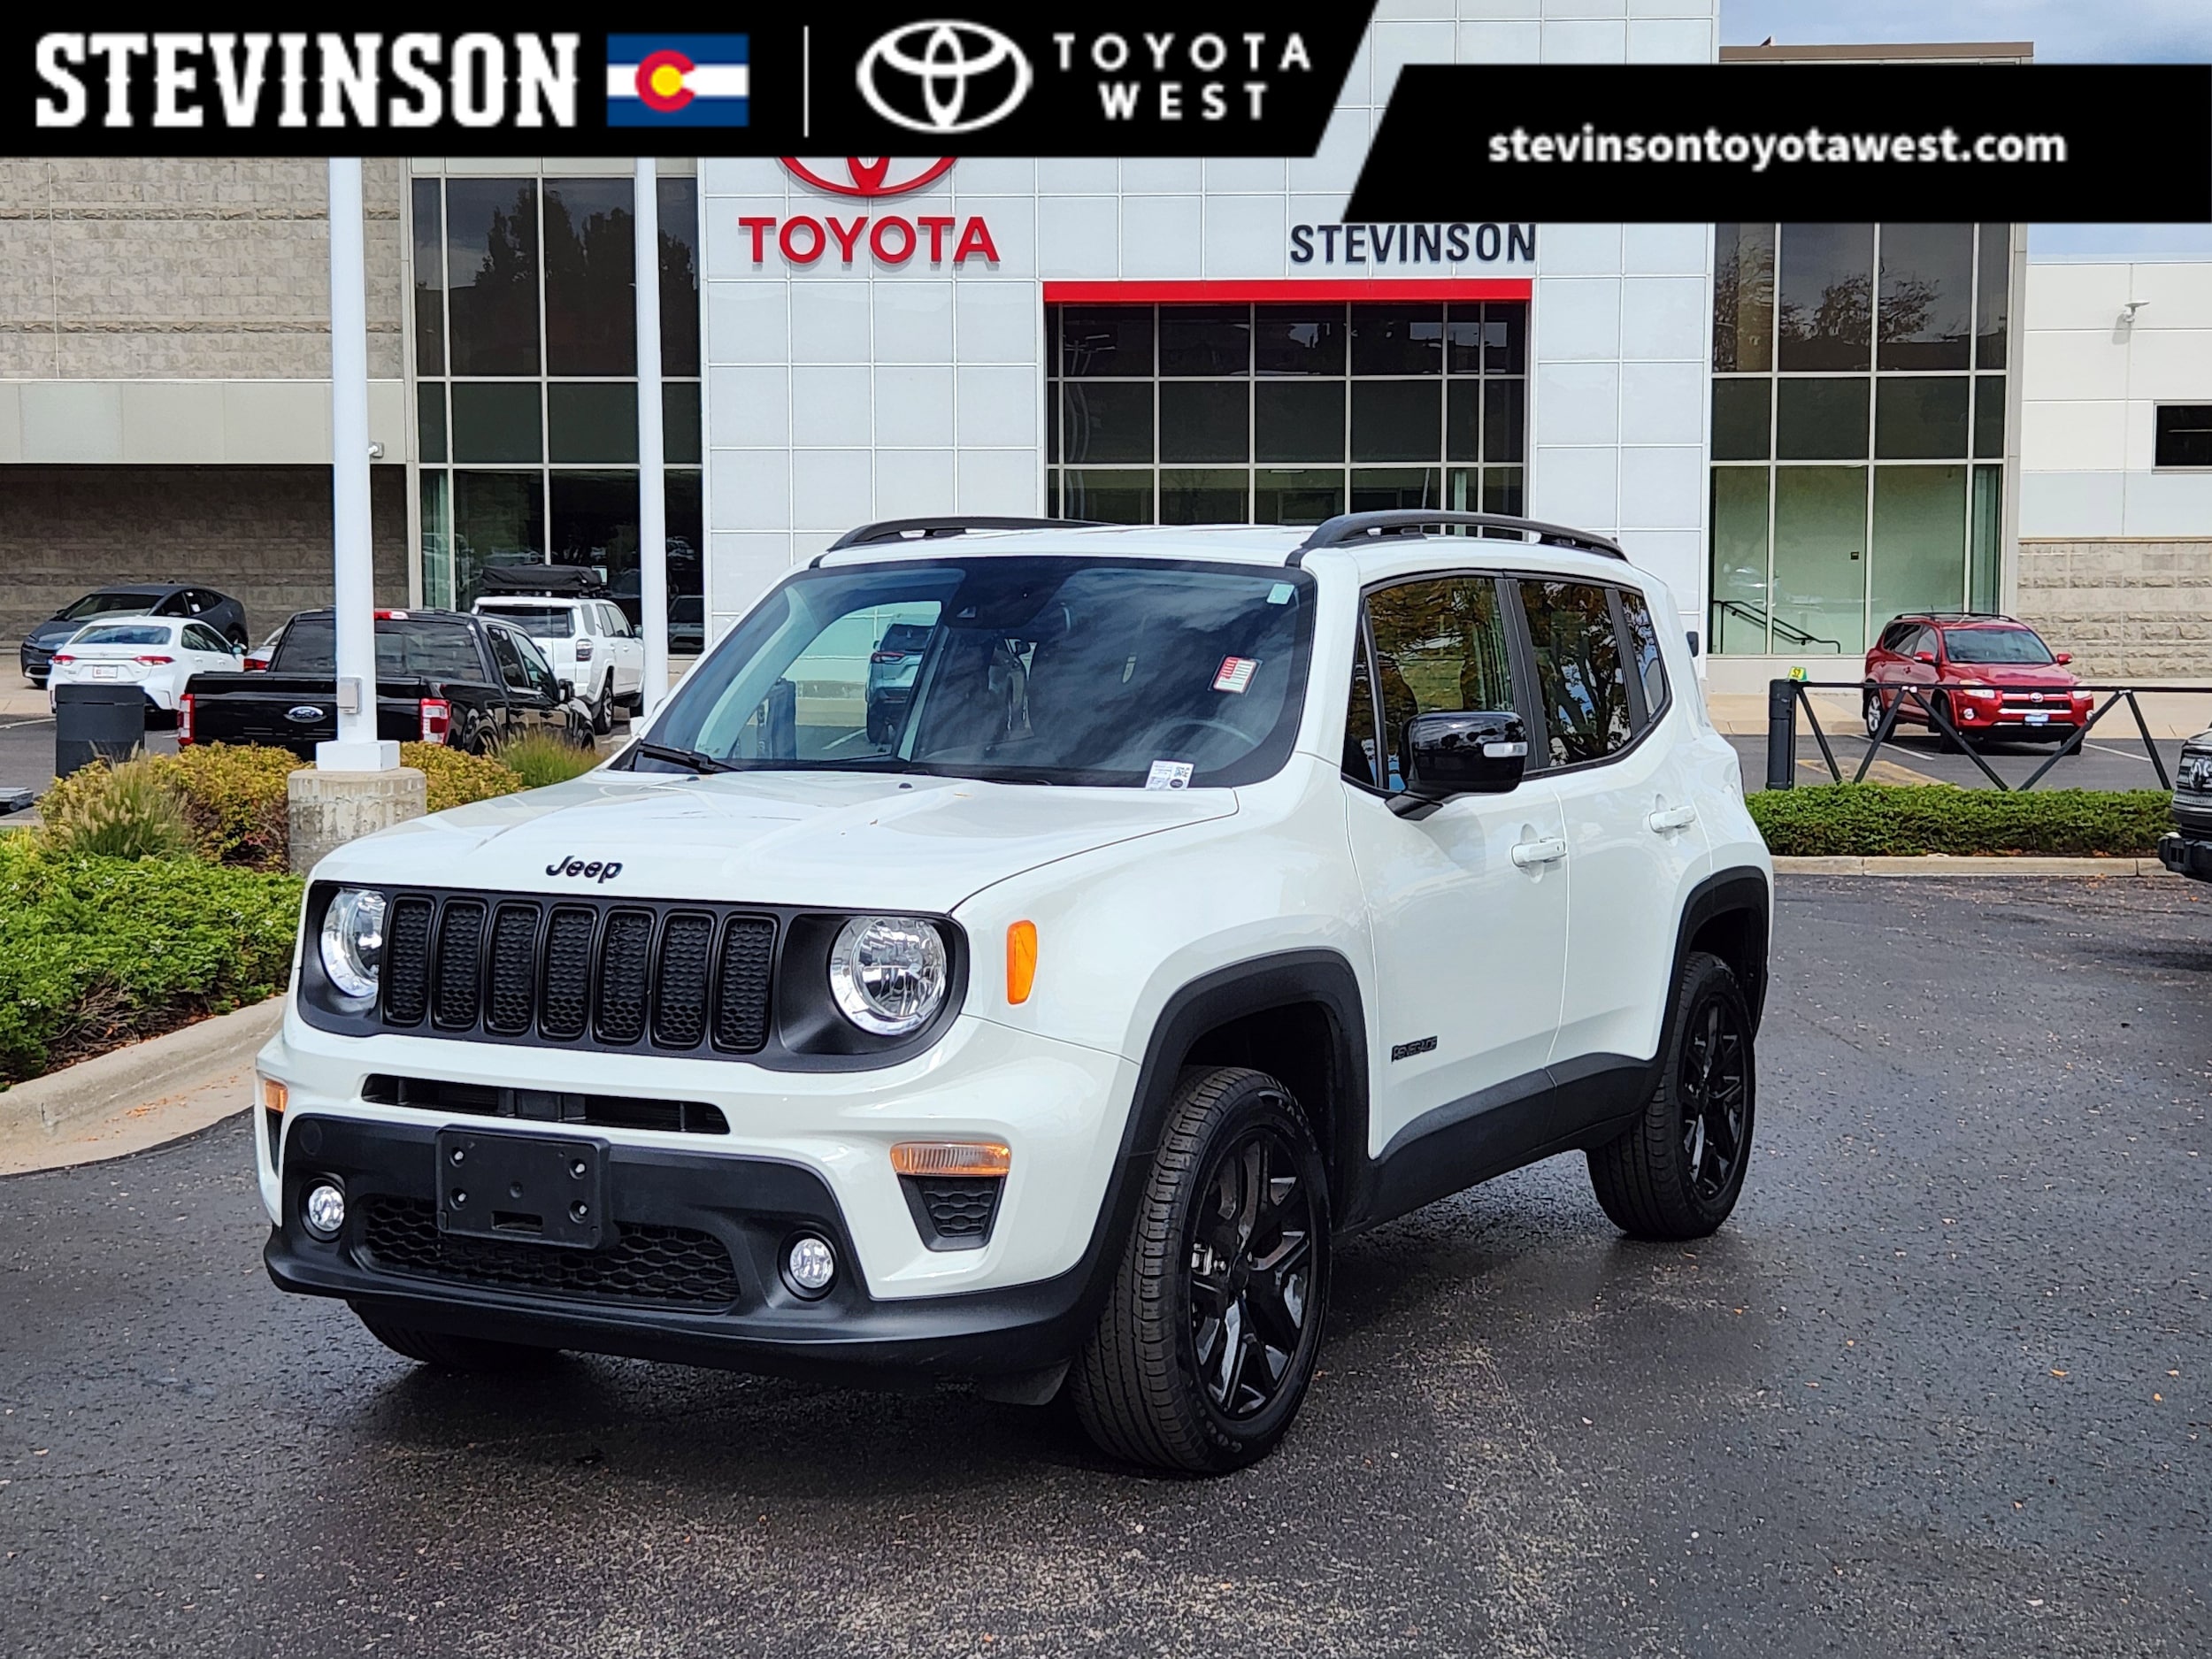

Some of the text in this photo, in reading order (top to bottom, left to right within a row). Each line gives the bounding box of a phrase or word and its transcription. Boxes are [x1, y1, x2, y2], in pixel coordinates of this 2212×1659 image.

[738, 216, 1000, 264] TOYOTA
[1289, 223, 1536, 264] STEVINSON
[545, 855, 623, 884] Jeep
